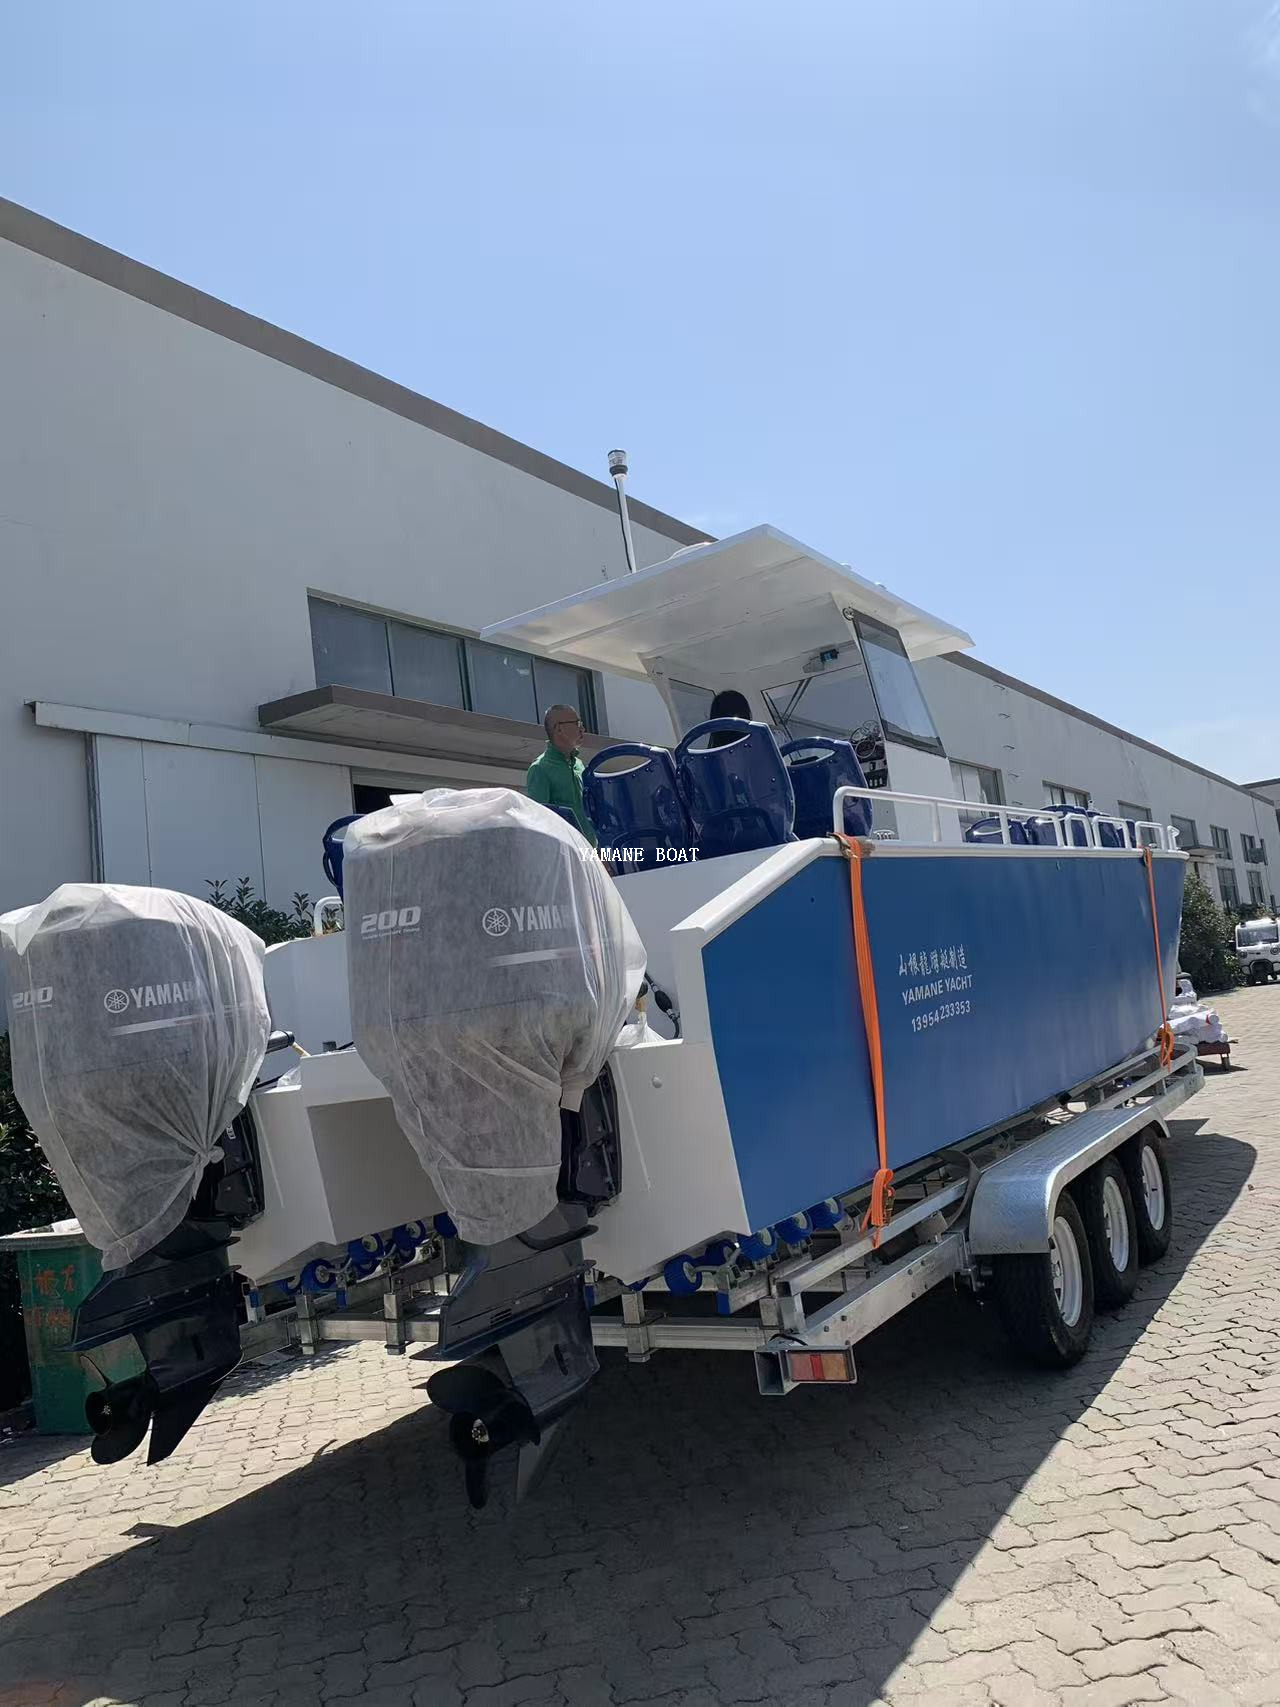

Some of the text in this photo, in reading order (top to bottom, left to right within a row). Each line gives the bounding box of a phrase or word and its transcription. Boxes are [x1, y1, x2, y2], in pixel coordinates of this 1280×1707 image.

[361, 905, 422, 935] 200
[902, 974, 973, 1006] YAMANE YACHT
[911, 1000, 971, 1033] 13954233353
